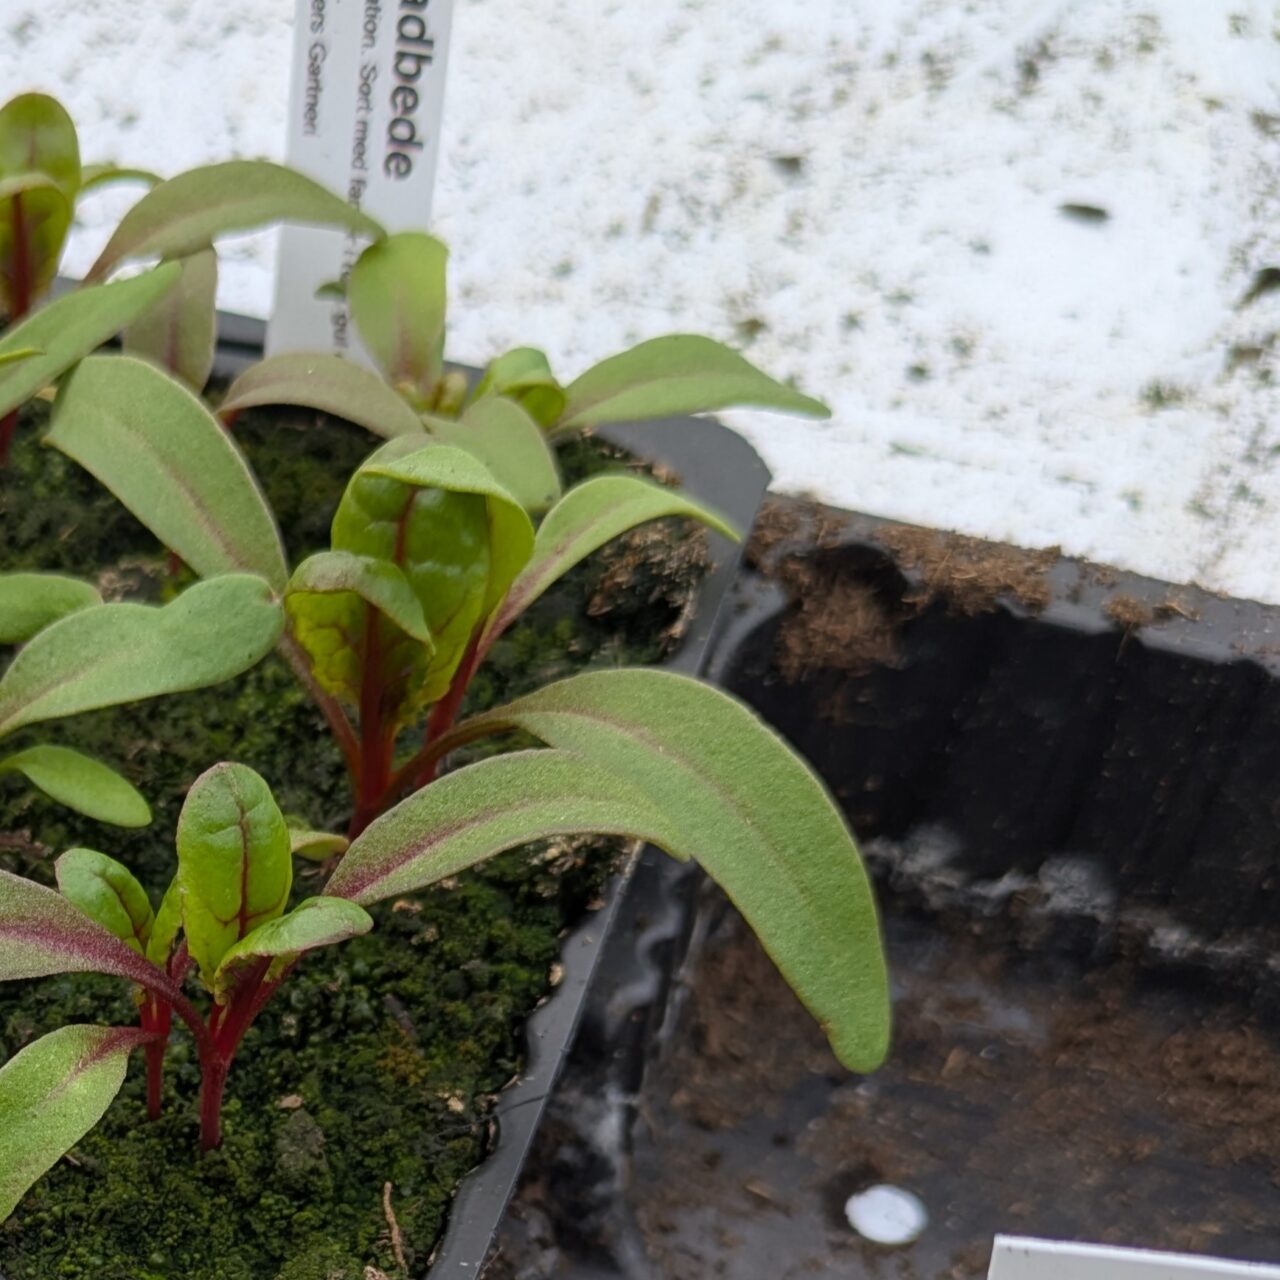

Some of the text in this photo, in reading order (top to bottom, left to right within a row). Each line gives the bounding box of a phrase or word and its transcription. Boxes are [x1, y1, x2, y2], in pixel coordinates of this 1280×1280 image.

[303, 41, 327, 138] Gartneri
[356, 63, 378, 114] Sort
[350, 120, 369, 171] med
